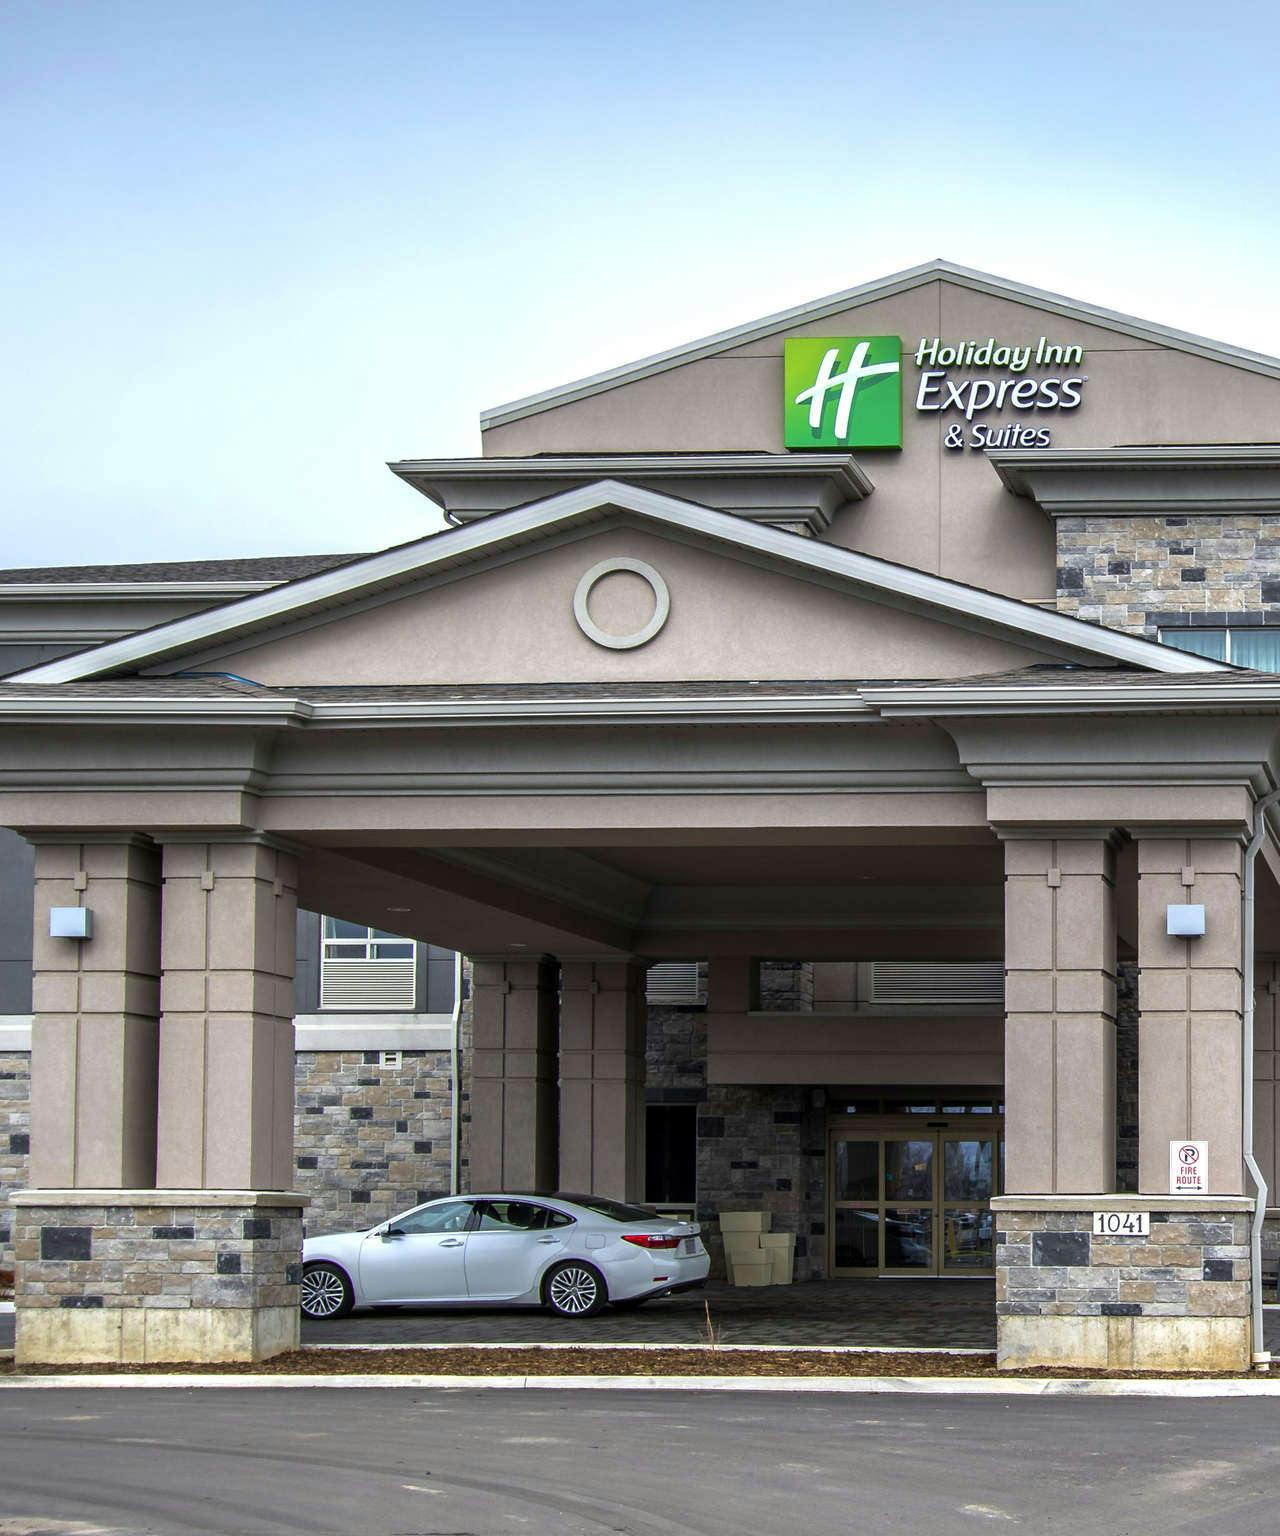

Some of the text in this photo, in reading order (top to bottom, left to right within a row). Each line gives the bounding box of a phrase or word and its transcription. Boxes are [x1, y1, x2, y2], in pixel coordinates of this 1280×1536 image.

[914, 336, 1083, 372] Holiday Inn
[915, 371, 1083, 421] Express
[944, 424, 1050, 448] & Suites
[1176, 1176, 1201, 1185] ROUTE
[1180, 1166, 1198, 1175] FIRE
[1098, 1213, 1143, 1233] 1041
